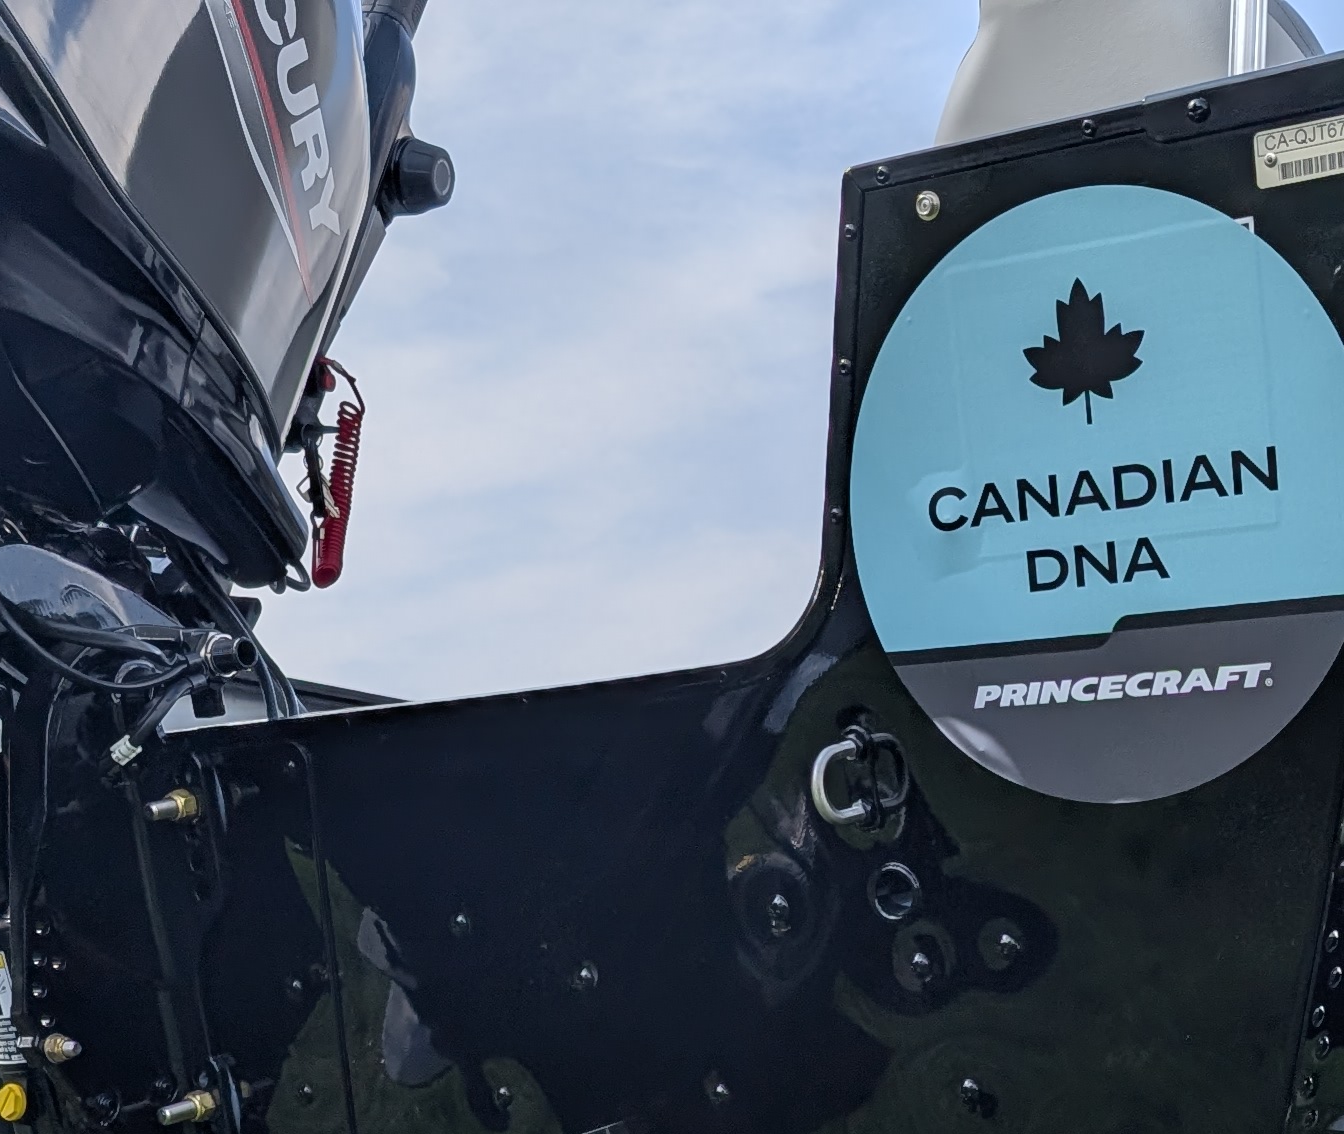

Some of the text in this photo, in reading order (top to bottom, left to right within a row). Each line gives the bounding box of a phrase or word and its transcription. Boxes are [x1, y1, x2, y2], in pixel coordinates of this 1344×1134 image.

[928, 446, 1279, 533] CANADIAN
[1026, 537, 1170, 592] DNA
[974, 662, 1273, 709] PRINCECRAFT
